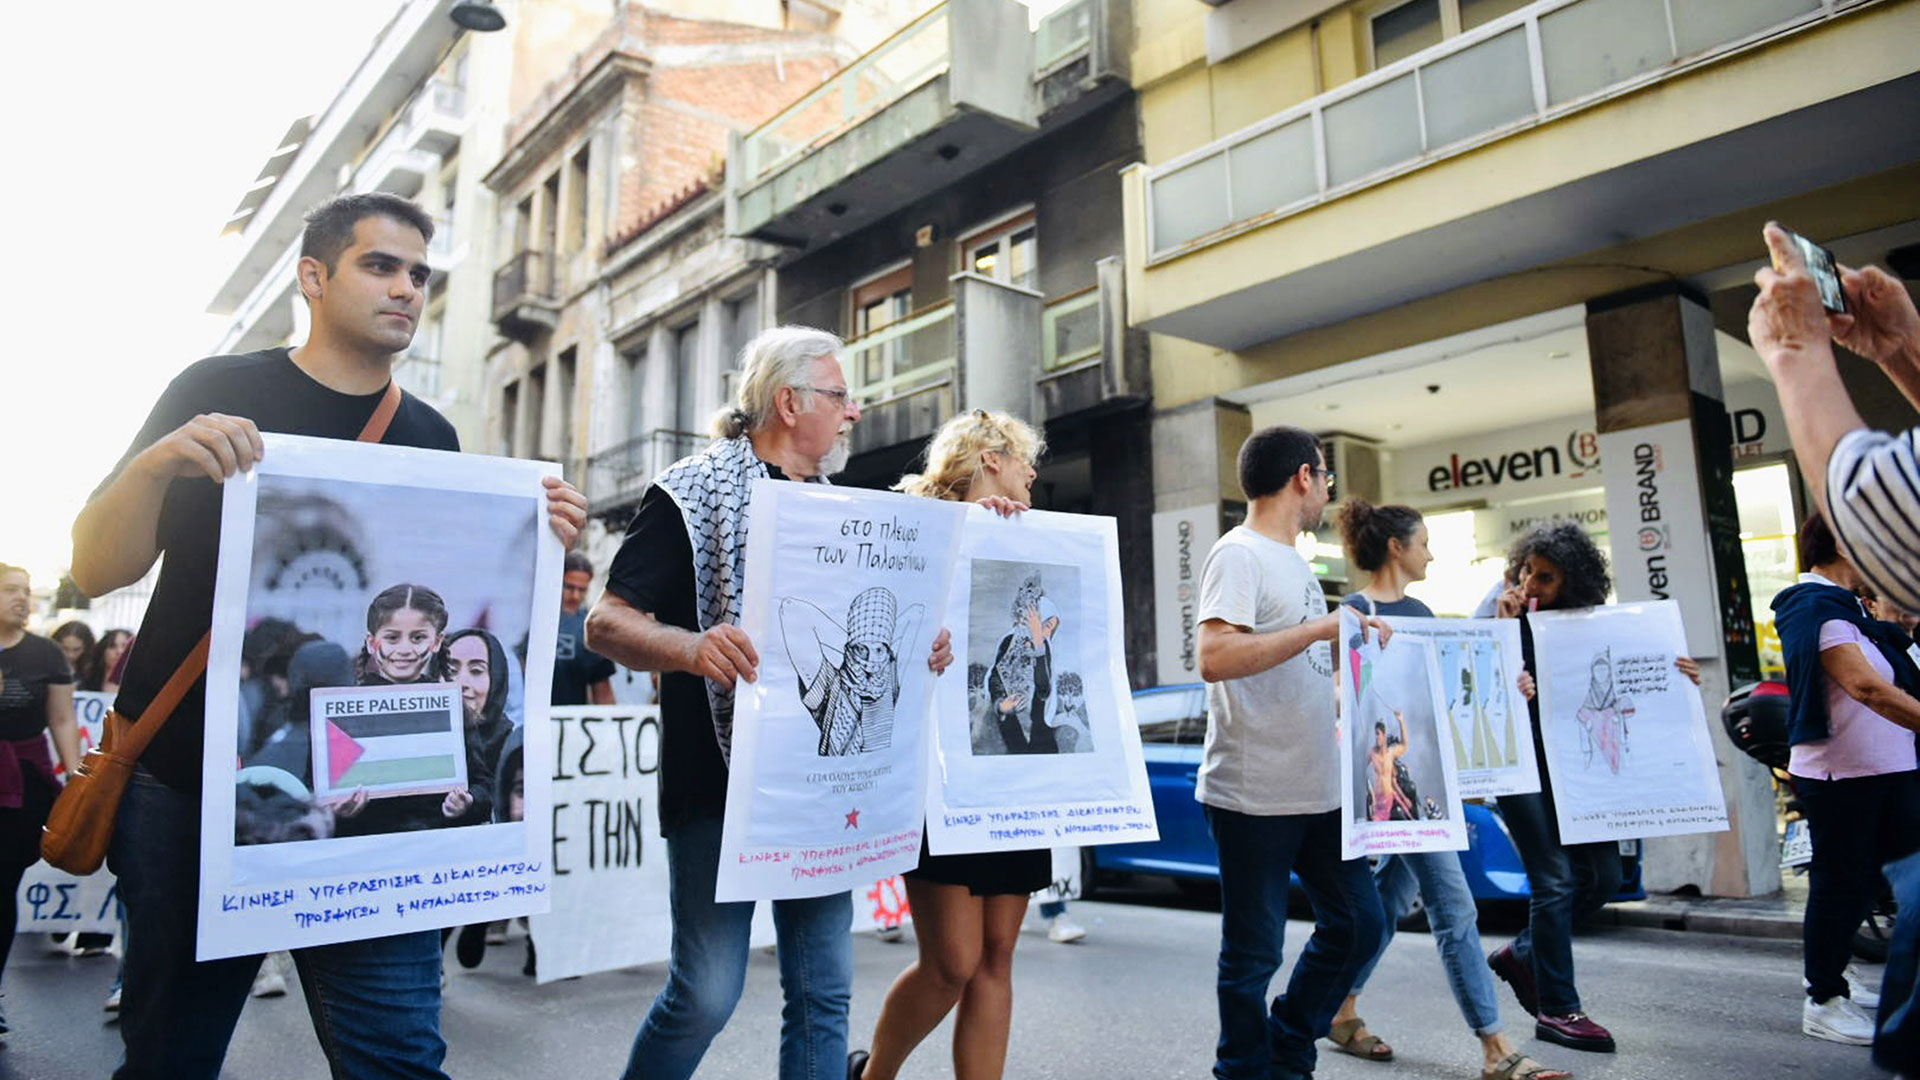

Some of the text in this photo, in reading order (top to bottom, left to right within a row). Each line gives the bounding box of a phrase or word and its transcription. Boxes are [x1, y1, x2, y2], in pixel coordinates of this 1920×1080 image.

[1428, 444, 1561, 492] eleven
[1634, 443, 1661, 522] BRAND
[840, 519, 873, 537] στο
[1178, 520, 1192, 580] BRAND
[814, 545, 848, 565] των
[1180, 605, 1195, 672] eleven
[325, 695, 450, 716] FREE PALESTINE
[584, 797, 643, 871] ΤΗΝ
[739, 851, 790, 865] ΚΙΝΗΣΗ
[222, 861, 543, 912] ΚΙΝΗΣΗ ΥΠΕΡΑΣΠΙΣΗΣ ΔΙΚΑΙΩΜΑΤΩΝ
[294, 906, 380, 929] ΠΡΟΣΦΥΓΩΝ
